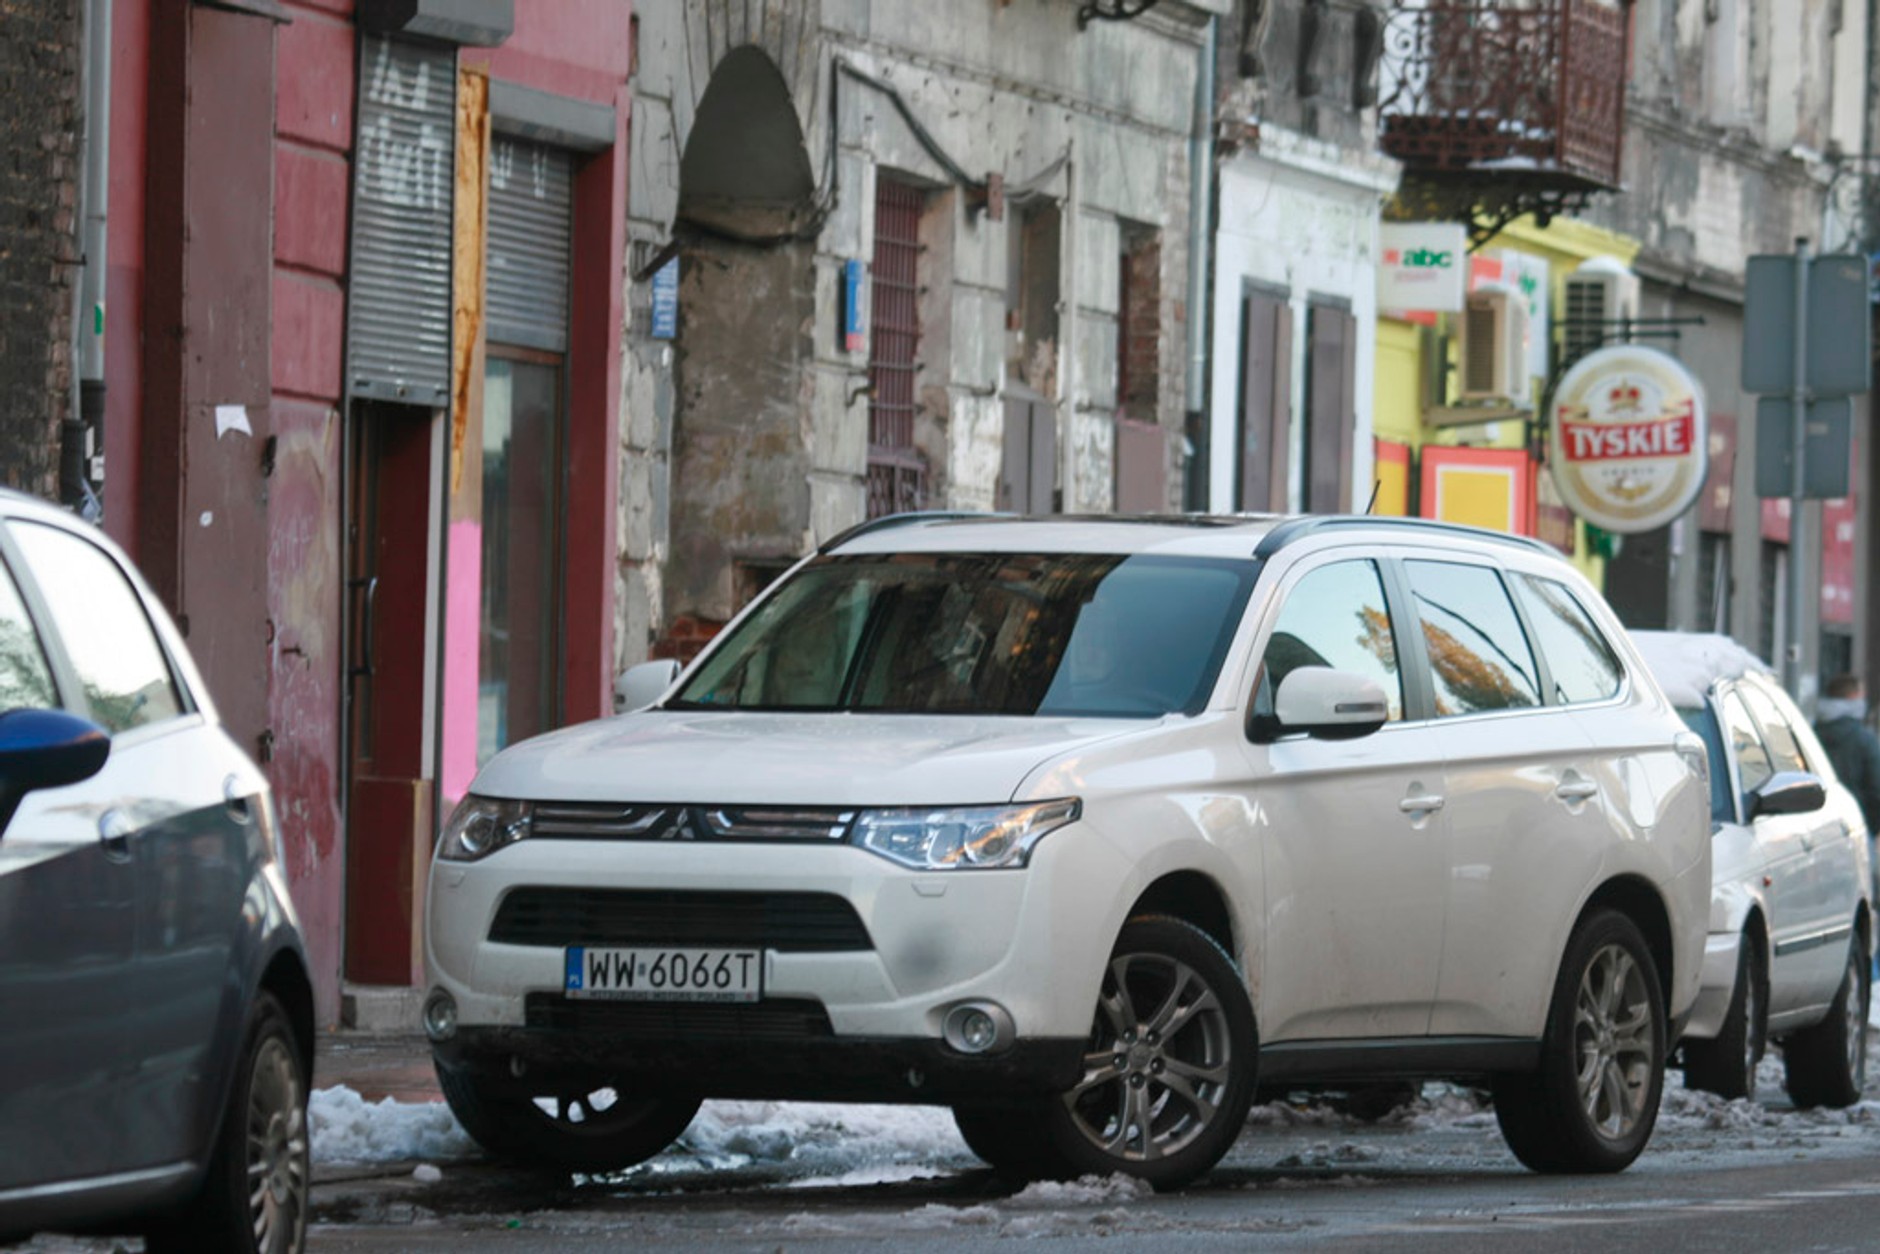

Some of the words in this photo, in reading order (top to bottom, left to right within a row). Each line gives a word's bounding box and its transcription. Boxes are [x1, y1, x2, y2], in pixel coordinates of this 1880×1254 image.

[1402, 246, 1453, 268] abc
[1568, 420, 1684, 458] TYSKIE
[588, 952, 636, 988] WW
[649, 953, 755, 989] 6066T
